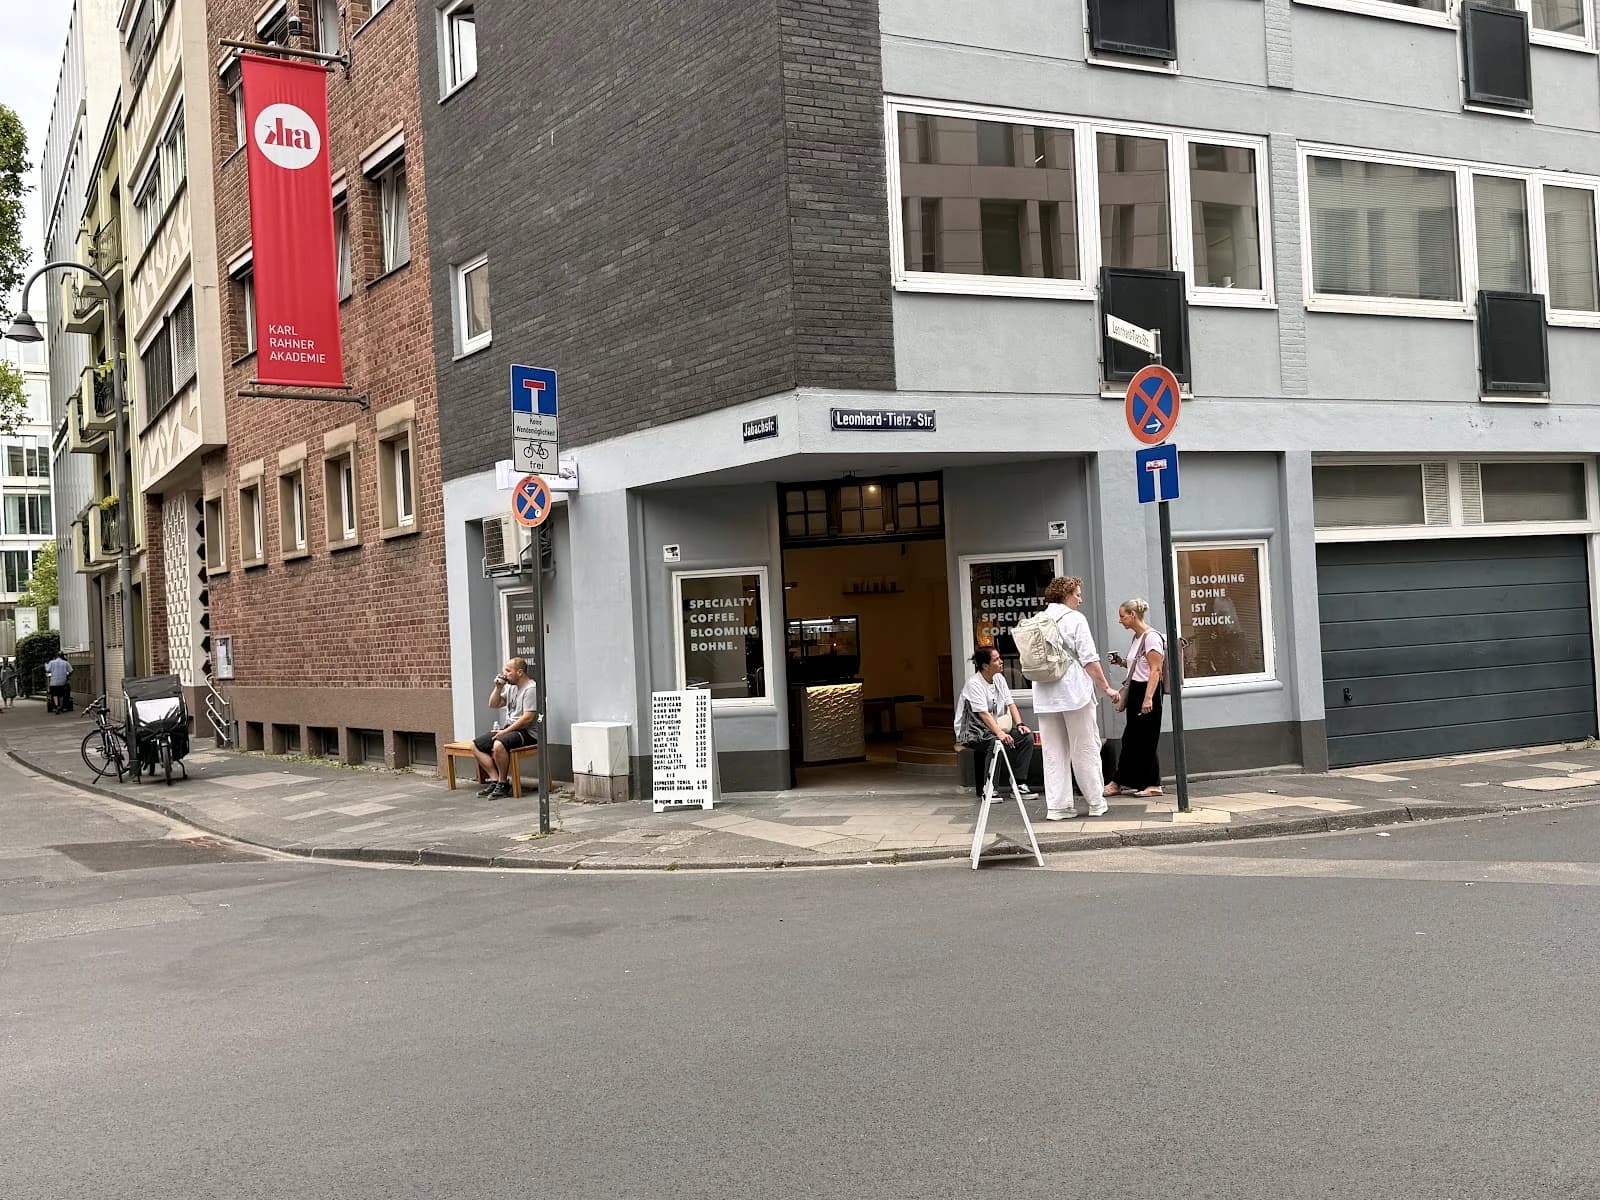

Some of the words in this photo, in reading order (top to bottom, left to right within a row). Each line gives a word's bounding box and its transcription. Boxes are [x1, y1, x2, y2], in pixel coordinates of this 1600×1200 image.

[269, 325, 298, 336] KARL
[269, 338, 314, 350] RAHNER
[270, 351, 326, 364] AKADEMIE
[836, 411, 934, 427] Leonhard-Tietz-Str.
[530, 460, 544, 470] frei
[1189, 574, 1245, 584] BLOOMING
[979, 583, 1025, 595] FRISCH
[1190, 588, 1226, 598] BOHNE
[689, 597, 754, 609] SPECIALTY
[980, 595, 1048, 609] GERÖSTET.
[1191, 603, 1206, 612] IST
[689, 612, 740, 623] COFFEE.
[1192, 612, 1235, 626] ZURÜCK.
[690, 626, 757, 638] BLOOMING
[982, 626, 1013, 637] COFF
[690, 641, 738, 652] BOHNE.
